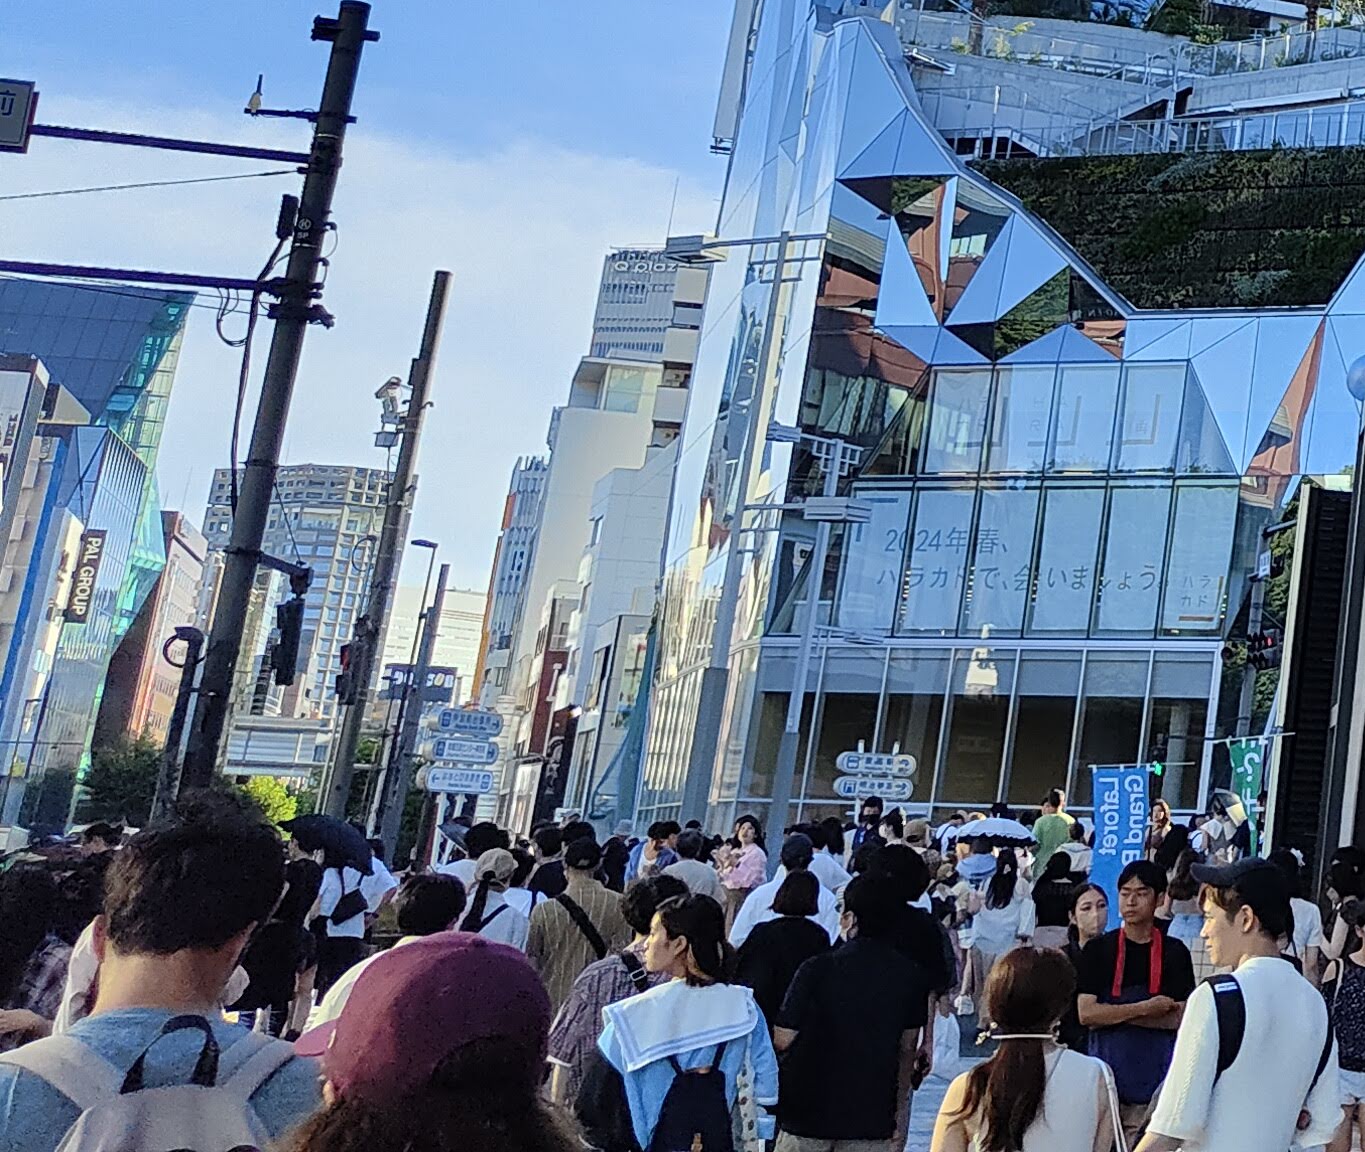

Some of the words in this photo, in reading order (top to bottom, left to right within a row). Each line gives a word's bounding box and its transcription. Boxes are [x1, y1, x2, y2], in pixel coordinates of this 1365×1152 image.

[634, 262, 678, 274] plaz
[83, 537, 102, 564] PAL
[72, 565, 94, 616] GROUP
